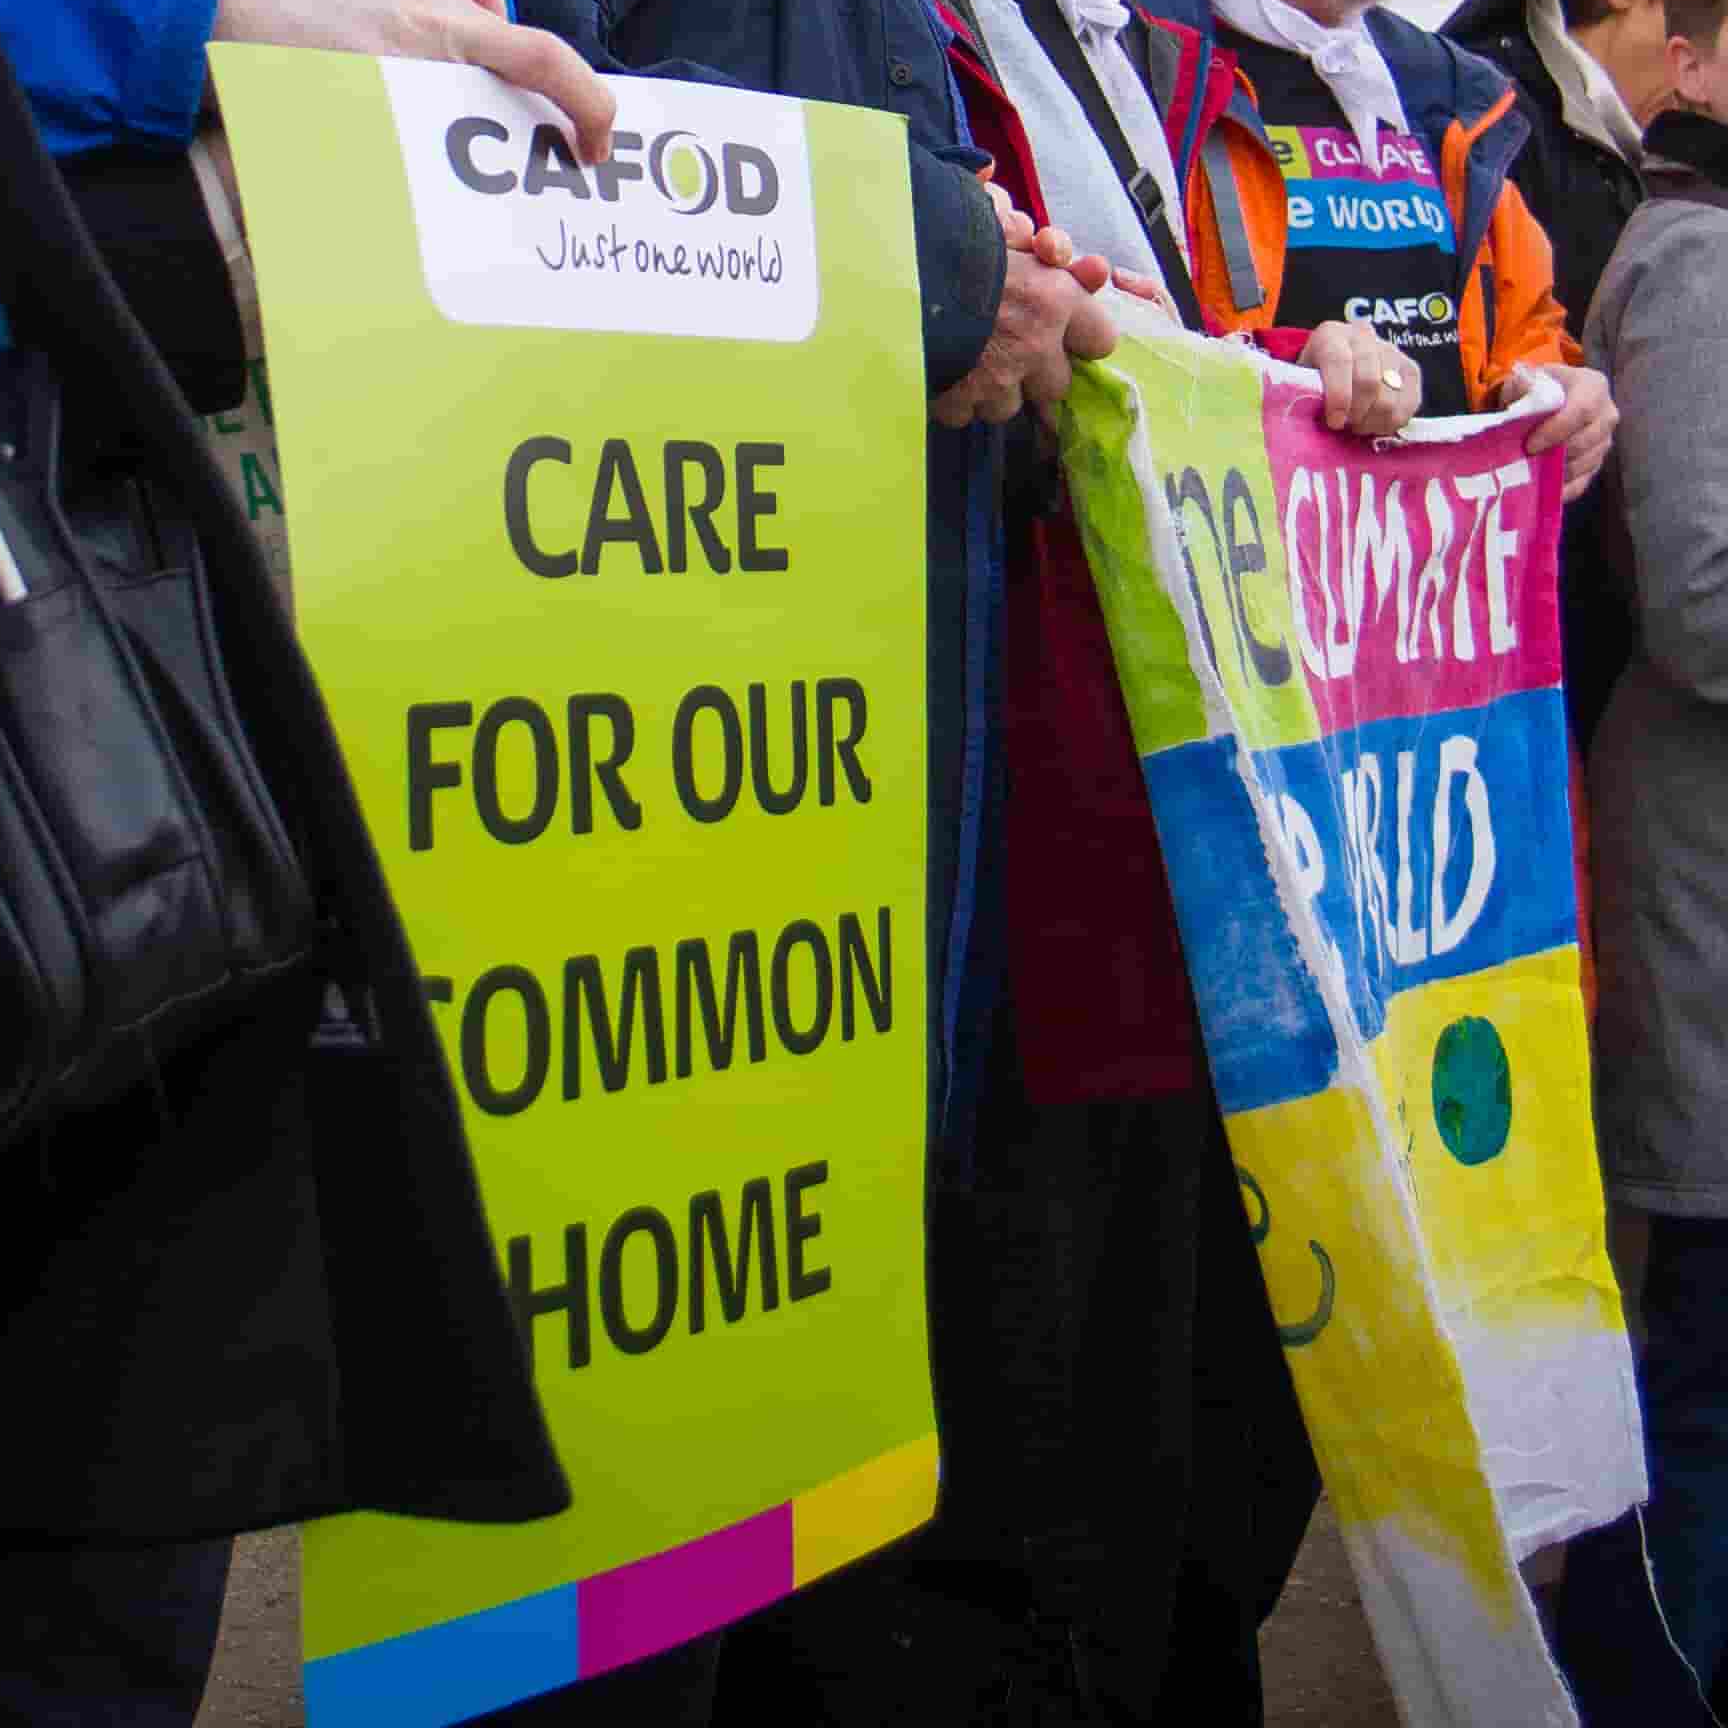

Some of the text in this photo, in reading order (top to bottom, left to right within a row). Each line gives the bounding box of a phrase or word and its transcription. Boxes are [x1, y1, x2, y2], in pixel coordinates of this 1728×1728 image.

[445, 116, 779, 216] CAFOD
[1326, 194, 1446, 233] WORLD
[1344, 292, 1455, 324] CAFO
[502, 435, 790, 579] CARE
[1165, 454, 1532, 687] ne CLIMATE
[406, 677, 872, 852] FOR OUR
[419, 906, 893, 1118] OMMON
[507, 1159, 832, 1370] HOME
